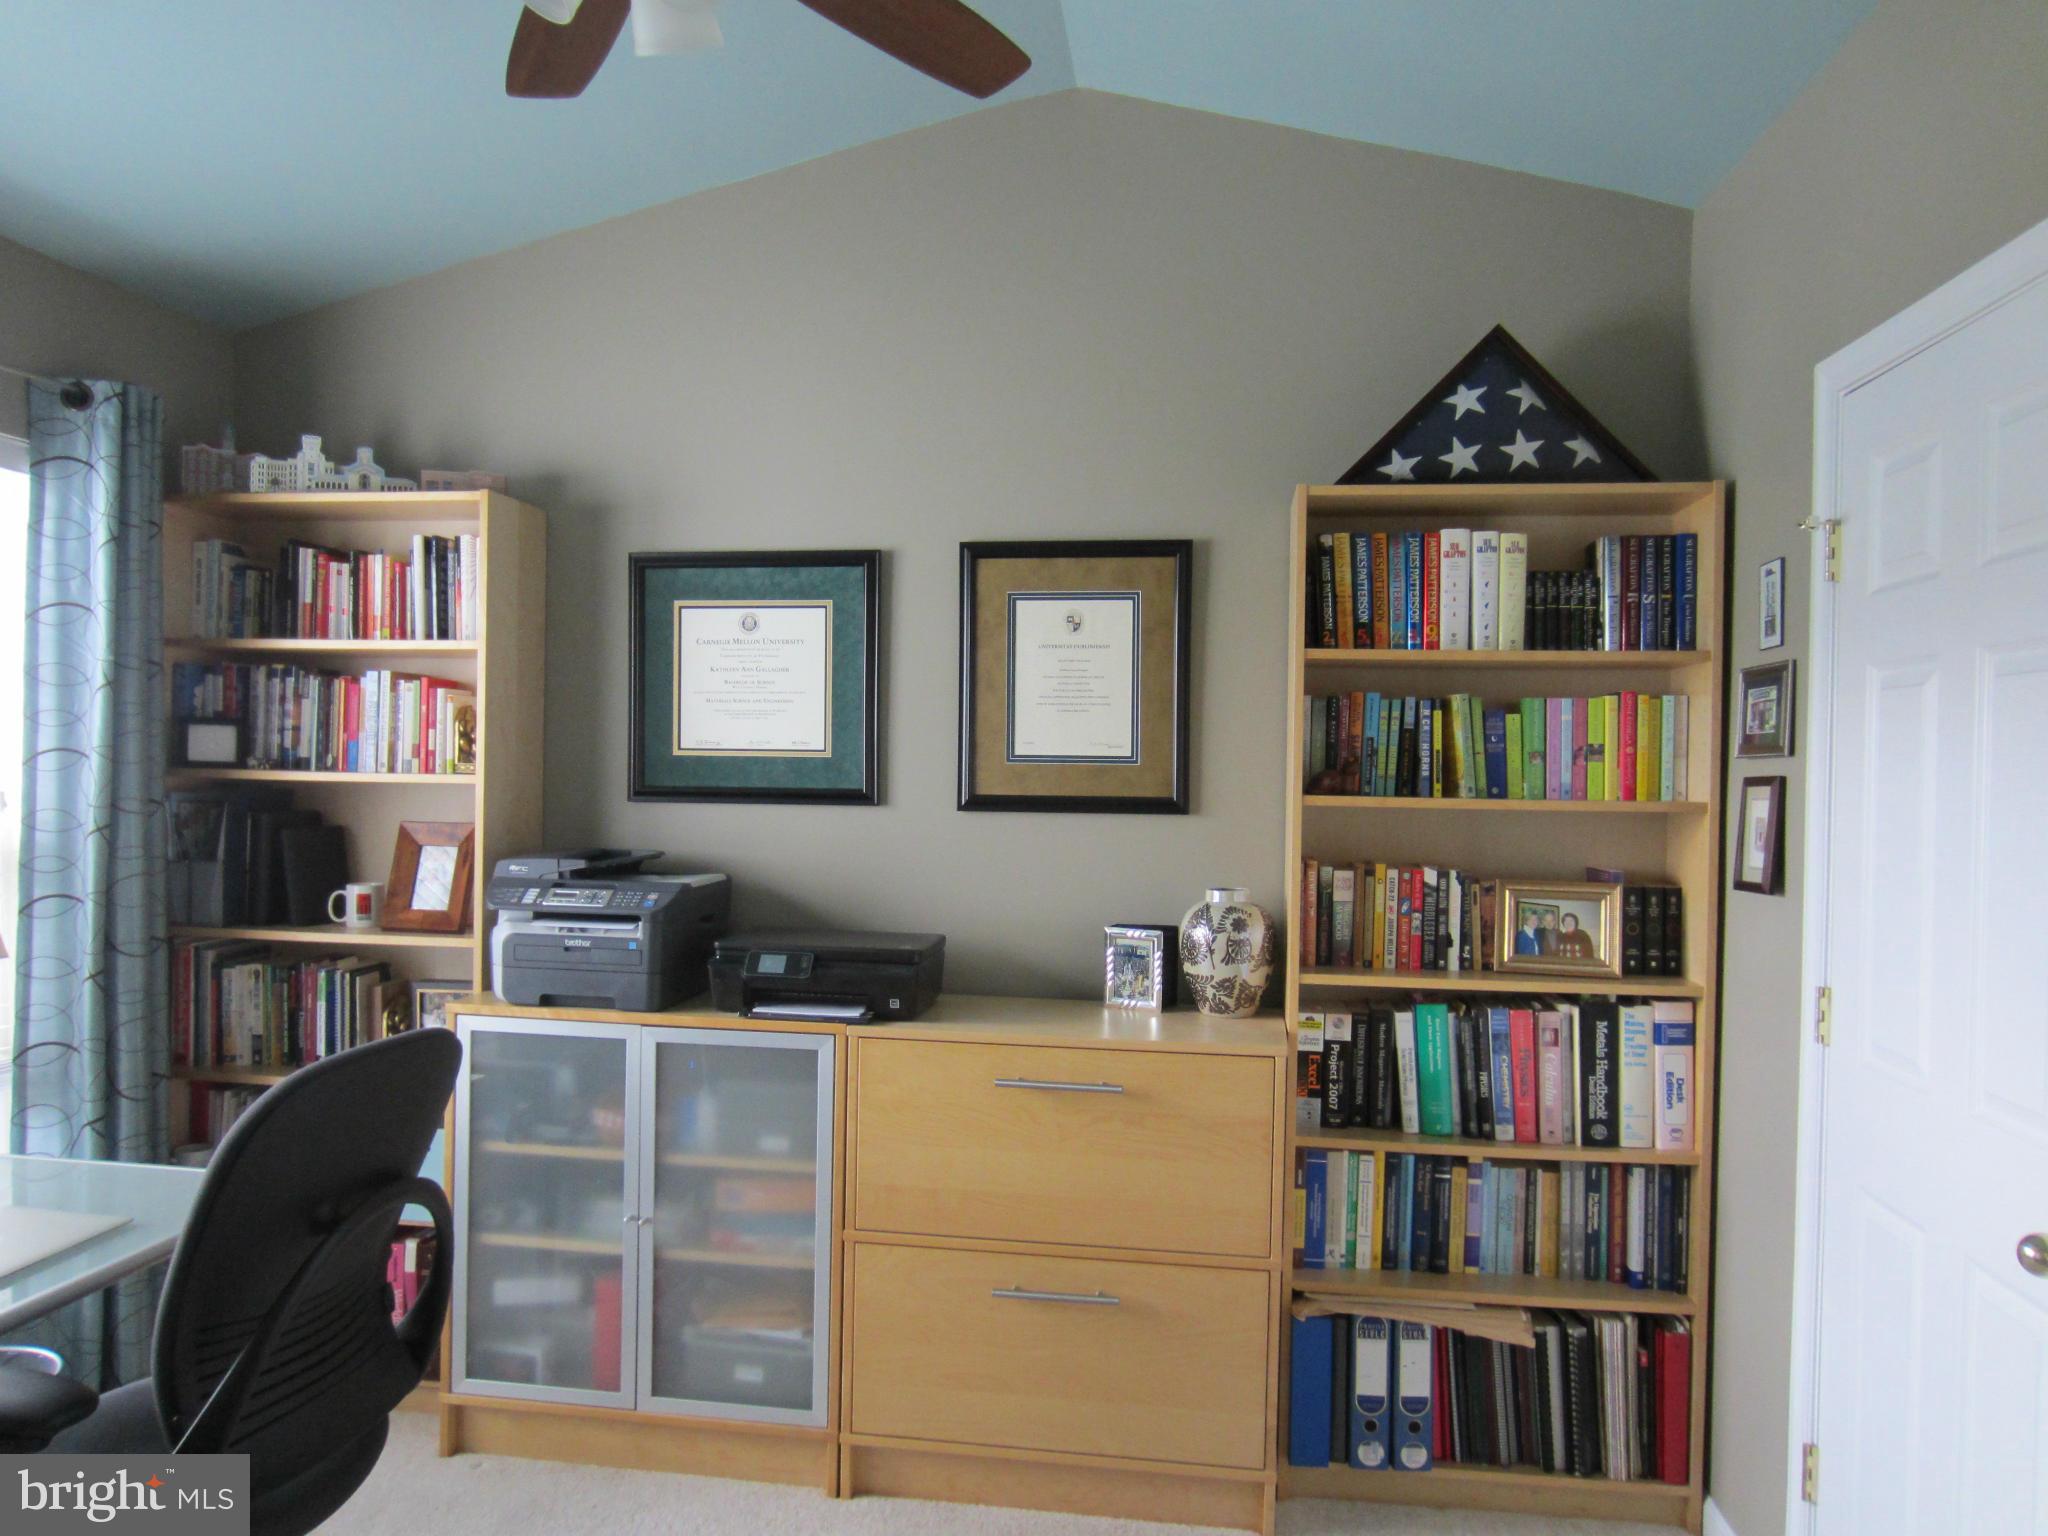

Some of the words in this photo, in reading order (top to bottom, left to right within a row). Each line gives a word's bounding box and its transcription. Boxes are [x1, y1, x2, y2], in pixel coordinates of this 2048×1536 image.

[1321, 556, 1331, 581] JAMES
[1355, 537, 1367, 567] JAMES
[1374, 537, 1384, 567] JAMES
[1408, 537, 1420, 567] JAMES
[1427, 537, 1437, 568] JAMES
[1323, 584, 1333, 630] PATTERSON
[1358, 569, 1368, 623] PATTERSON
[1375, 568, 1385, 622] PATTERSON
[1410, 569, 1420, 623] PATTERSON
[1428, 569, 1438, 623] PATTERSON
[732, 638, 760, 646] MELLON
[763, 638, 805, 646] UNIVERSITY
[1424, 896, 1437, 941] MIDDLESEX
[564, 939, 592, 948] brother
[1596, 1020, 1608, 1058] Metals
[1308, 1055, 1321, 1089] Excel
[1328, 1044, 1340, 1080] Project
[1329, 1083, 1338, 1110] 2007
[1500, 1055, 1510, 1108] CHEMISTRY
[1544, 1053, 1557, 1106] Calculus
[1589, 1076, 1597, 1093] Desk
[1665, 1071, 1675, 1110] Edition
[1676, 1077, 1685, 1104] Desk
[1589, 1094, 1597, 1119] Edition
